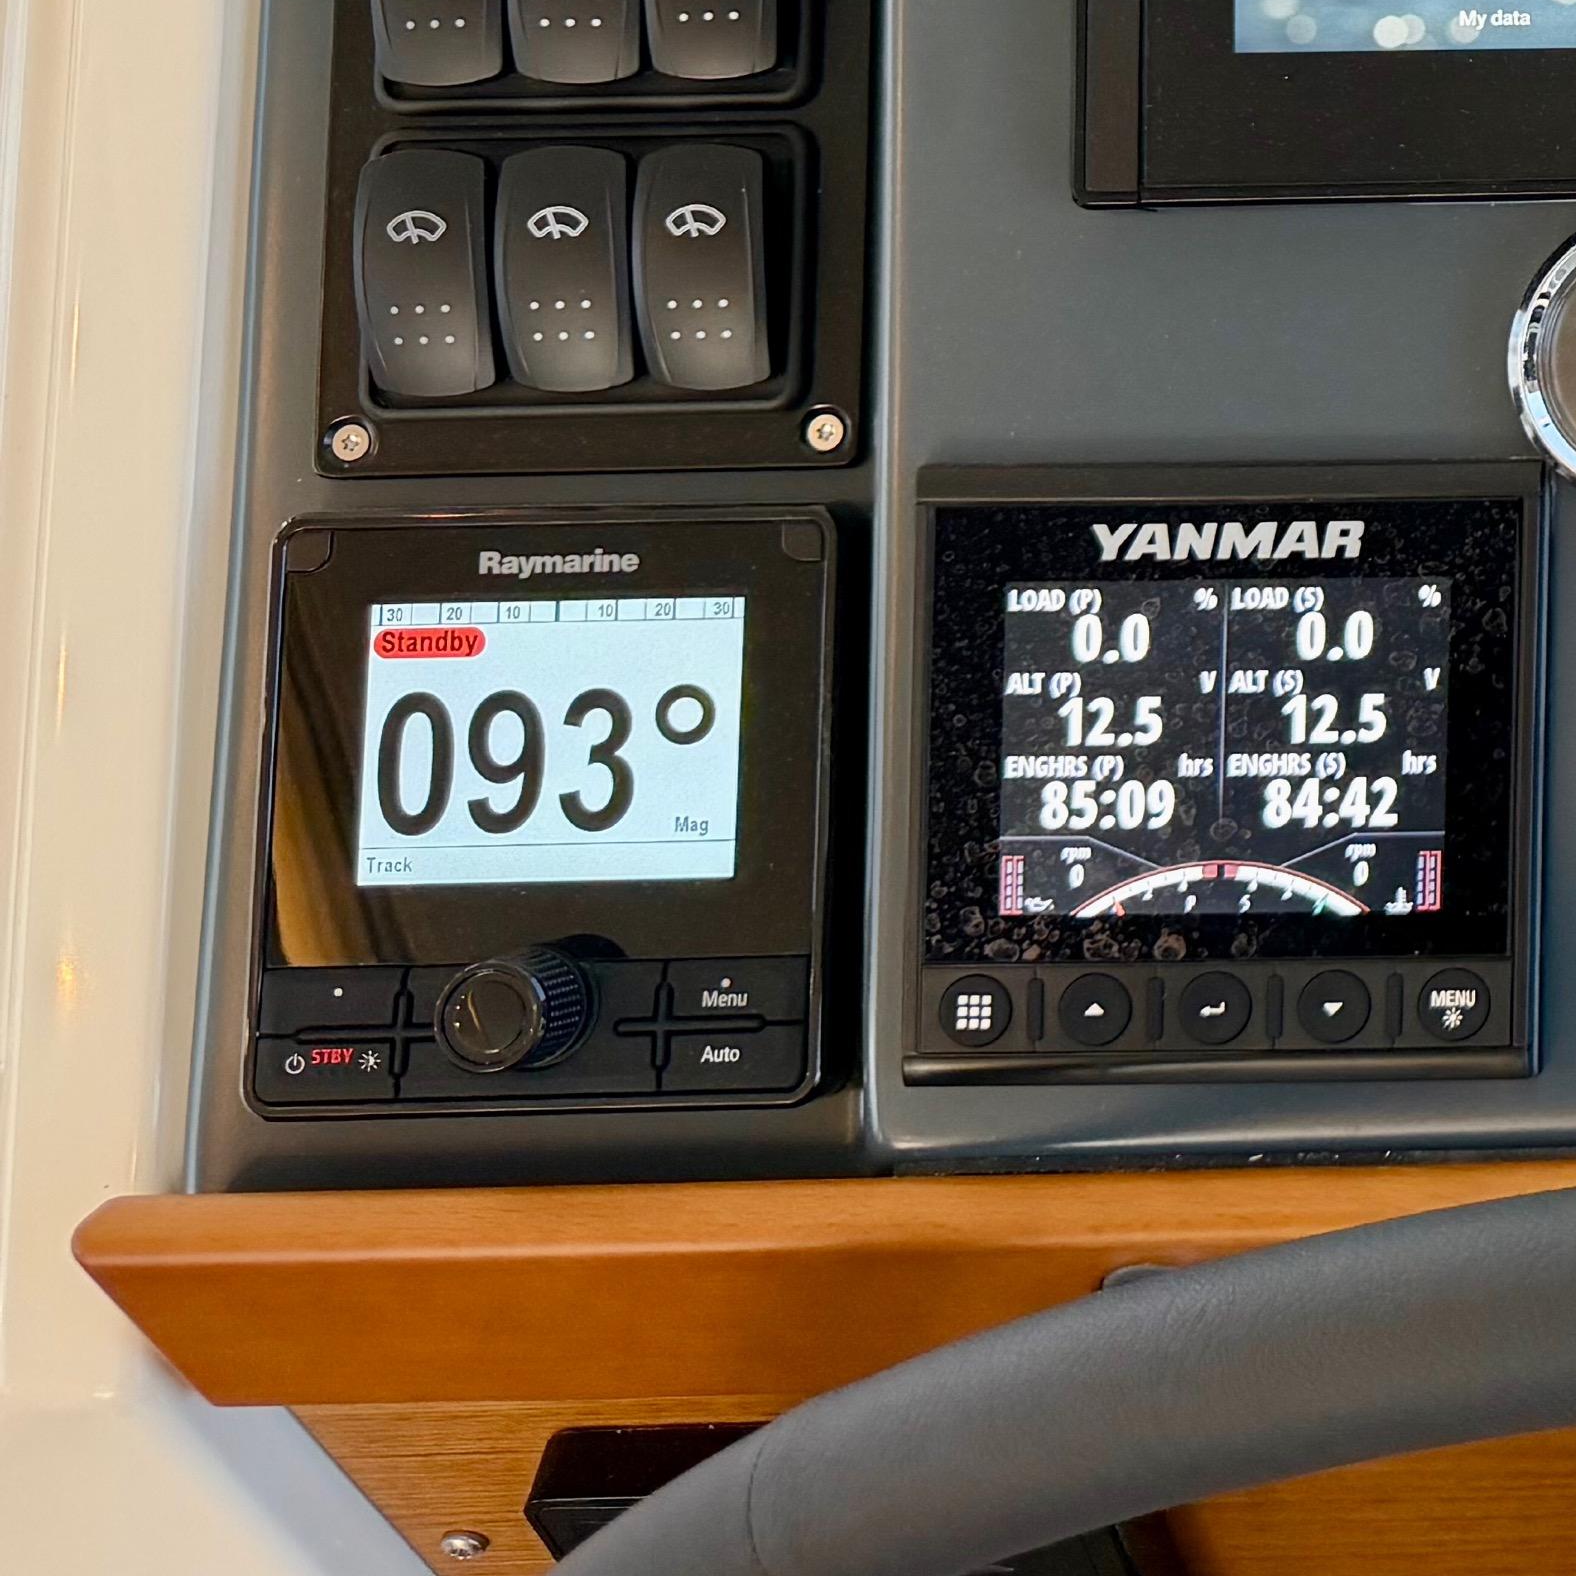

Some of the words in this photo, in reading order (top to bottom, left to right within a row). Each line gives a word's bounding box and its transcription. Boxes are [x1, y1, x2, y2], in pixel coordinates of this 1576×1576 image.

[1459, 10, 1488, 30] My
[1491, 10, 1531, 27] data
[1092, 520, 1366, 562] YANMAR
[479, 547, 640, 581] Raymarine
[387, 607, 403, 622] 30
[446, 606, 463, 621] 20
[506, 605, 521, 620] 10
[598, 603, 614, 618] 10
[655, 602, 672, 617] 20
[713, 601, 730, 616] 30
[1007, 588, 1066, 613] LOAD
[1069, 588, 1102, 616] (P)
[1194, 587, 1218, 611] %
[1230, 586, 1289, 611] LOAD
[1293, 586, 1324, 613] (S)
[1418, 584, 1442, 608] %
[381, 631, 479, 657] Standby
[1072, 612, 1151, 664] 0.0
[1296, 610, 1375, 661] 0.0
[1005, 672, 1046, 696] ALT
[1050, 672, 1082, 698] (P)
[1200, 670, 1217, 693] V
[1227, 670, 1270, 694] ALT
[1272, 670, 1304, 697] (S)
[1423, 667, 1441, 691] V
[1057, 695, 1164, 747] 12.5
[1281, 693, 1388, 746] 12.5
[377, 683, 717, 837] 093°
[1003, 755, 1088, 779] ENGHRS
[1092, 755, 1125, 781] (P)
[1178, 753, 1214, 778] hrs
[1226, 753, 1312, 778] ENGHRS
[1316, 752, 1346, 779] (S)
[1401, 750, 1438, 776] hrs
[1039, 779, 1176, 830] 85:09
[1262, 776, 1399, 829] 84:42
[675, 816, 709, 836] Mag
[367, 856, 413, 874] Track
[1060, 846, 1092, 864] rpm
[1344, 842, 1377, 863] rpm
[1069, 863, 1085, 889] 0
[1353, 861, 1369, 887] 0
[701, 990, 749, 1008] Menu
[1430, 989, 1476, 1008] MENU
[311, 1047, 354, 1065] STBY
[701, 1046, 741, 1064] Auto
